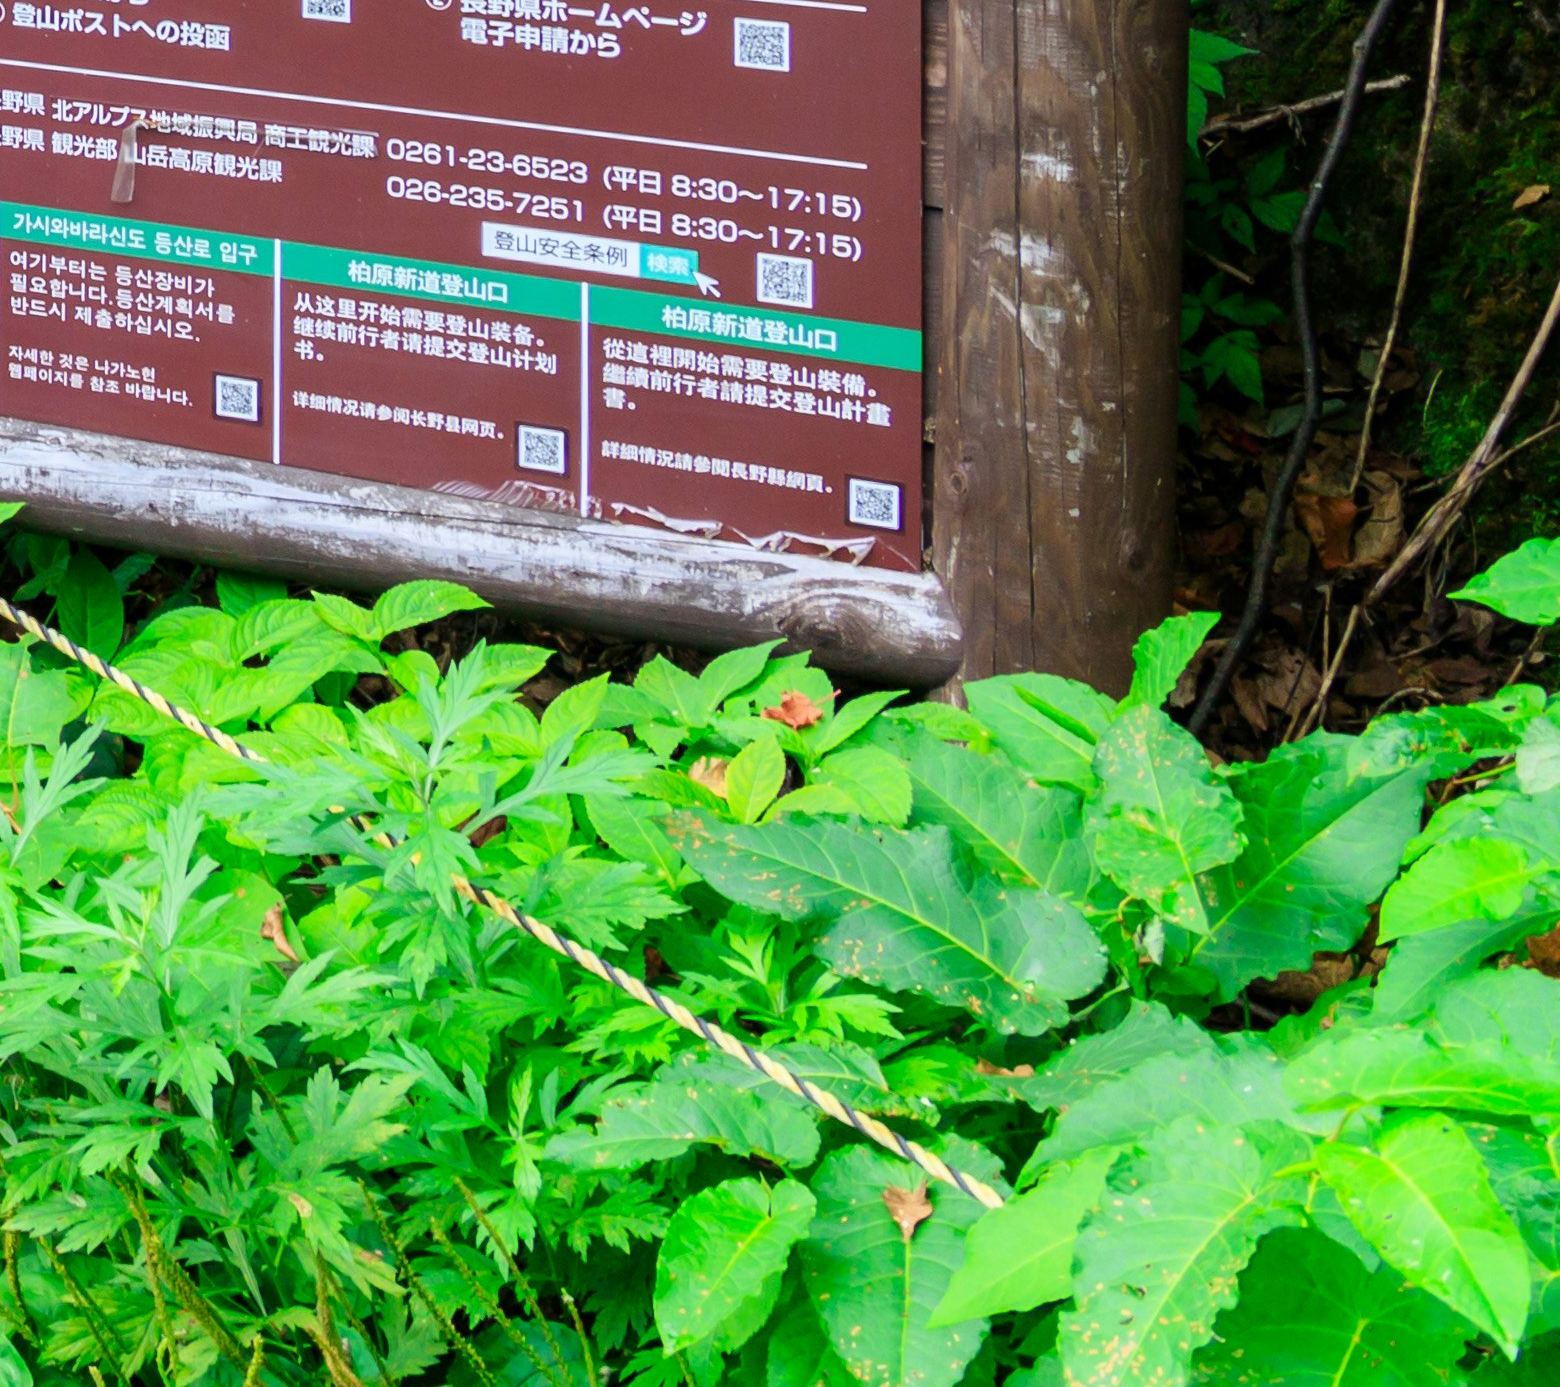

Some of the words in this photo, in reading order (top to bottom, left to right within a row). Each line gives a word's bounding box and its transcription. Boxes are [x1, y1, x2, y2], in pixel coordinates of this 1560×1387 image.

[11, 4, 231, 50] 登山ポストへの投函
[460, 19, 620, 58] 電子申請から
[52, 133, 117, 161] 観光部
[387, 139, 588, 184] 0261-23-6523
[387, 176, 583, 223] 026-235-7251
[13, 213, 146, 249] 가시와바라신도
[154, 232, 211, 258] 등산로
[220, 242, 258, 265] 입구
[494, 229, 628, 269] 登山安全条例
[10, 251, 107, 281] 여기부터는
[115, 266, 214, 297] 등산장비가
[348, 260, 508, 303] 柏原新道登山口
[647, 251, 690, 277] 検索
[10, 297, 66, 321] 반드시
[74, 305, 200, 342] 제출하십시오.
[294, 292, 545, 347] 从这里开始需要登山装备。
[662, 305, 837, 352] 柏原新道登山口
[9, 346, 53, 366] 자세한
[60, 353, 89, 371] 것은
[95, 359, 156, 383] 나가노현
[294, 315, 556, 375] 继续前行者请提交登山计划
[294, 341, 324, 361] 书。
[603, 337, 876, 398] 從這裡開始需要登山裝備。
[9, 363, 84, 389] 웹페이지를
[90, 376, 119, 394] 참조
[125, 383, 192, 407] 바랍니다.
[602, 363, 891, 427] 繼續前行者請提交登山計畫
[603, 387, 636, 410] 書。
[293, 391, 504, 439] 详细情况请参阅长野县网页。
